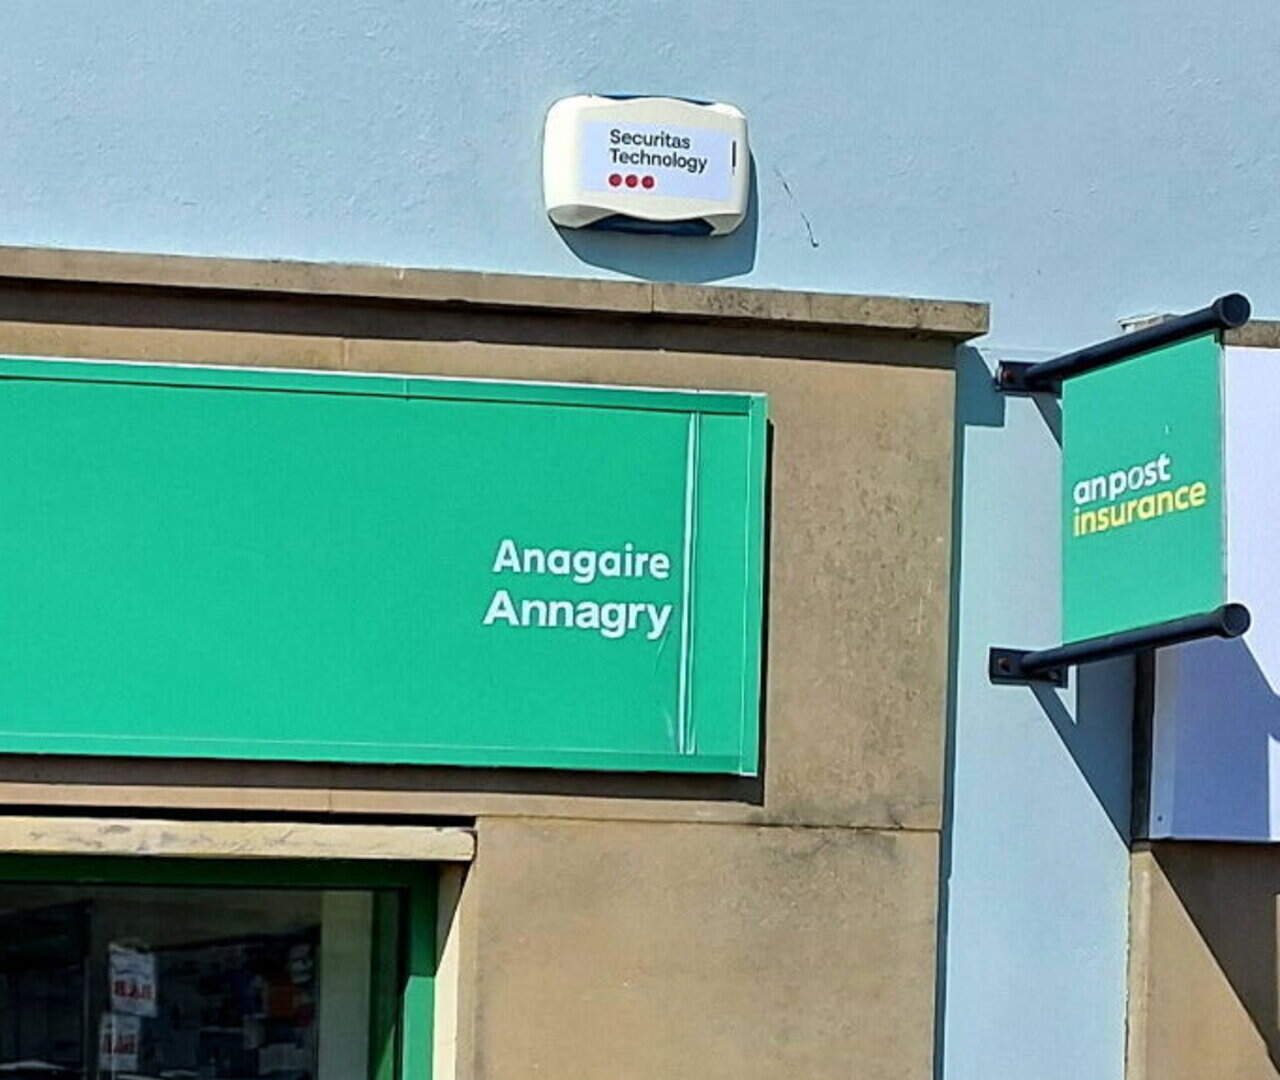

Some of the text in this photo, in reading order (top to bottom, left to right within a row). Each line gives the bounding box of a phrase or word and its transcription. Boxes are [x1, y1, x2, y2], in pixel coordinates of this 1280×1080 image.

[609, 128, 691, 150] Securitas
[609, 148, 708, 174] Technology
[1073, 481, 1208, 538] insurance
[492, 539, 671, 583] Anagaire
[482, 590, 673, 640] Annagry
